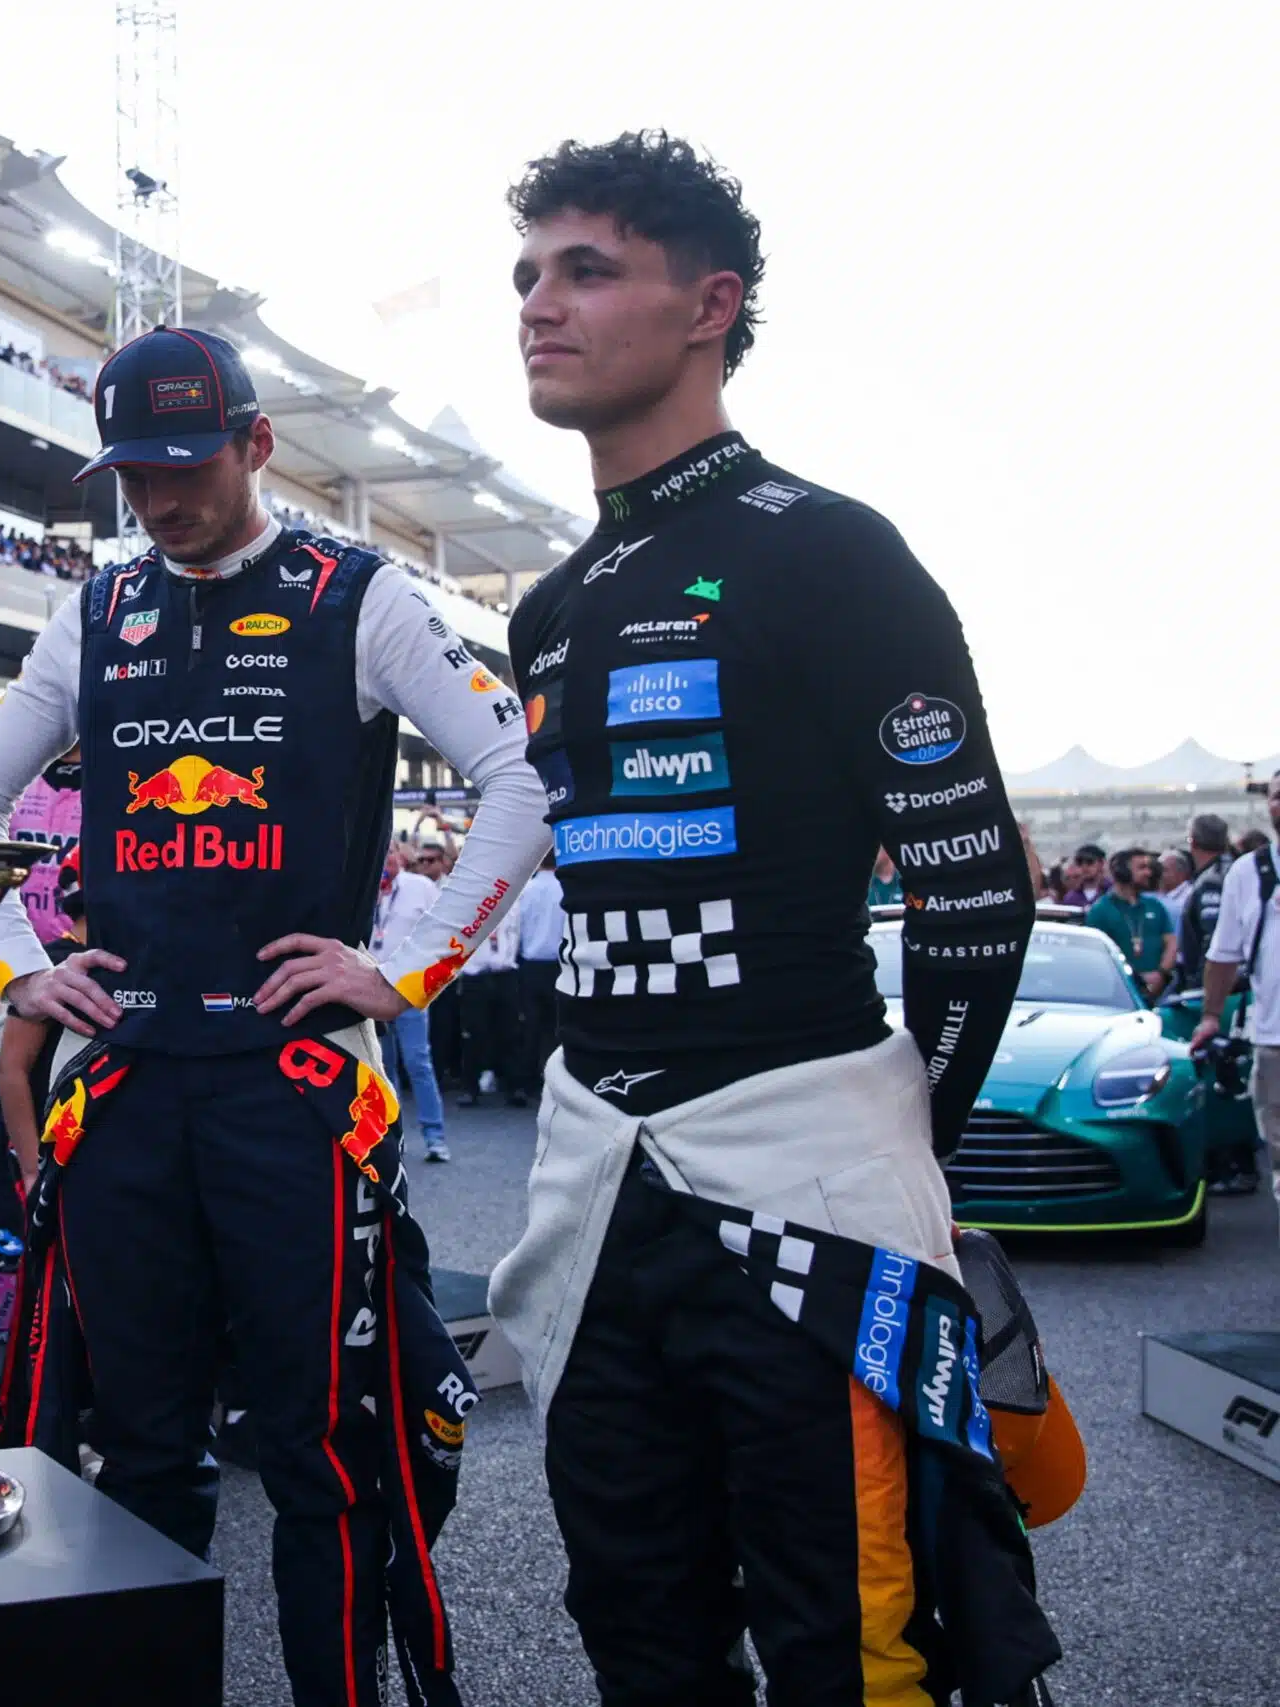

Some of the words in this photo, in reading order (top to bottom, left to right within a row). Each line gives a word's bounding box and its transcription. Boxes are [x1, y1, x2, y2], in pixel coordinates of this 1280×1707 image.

[157, 381, 202, 392] ORACLE
[104, 384, 116, 420] 1
[651, 442, 747, 501] MONSTER
[128, 613, 157, 626] TAG
[246, 621, 282, 631] RAUCH
[620, 620, 698, 636] McLaren
[104, 660, 148, 682] Mobil
[223, 687, 287, 697] HONDA
[113, 716, 284, 748] ORACLE
[892, 709, 951, 734] Estrella
[897, 725, 952, 749] Galicia
[624, 748, 713, 784] allwyn
[910, 776, 988, 809] Dropbox
[116, 823, 185, 872] Red
[194, 824, 284, 871] Bull
[561, 819, 723, 856] Technologies
[461, 907, 489, 938] Red
[482, 878, 510, 911] Bull
[925, 889, 1015, 912] Airwallex
[928, 941, 1018, 958] CASTORE
[114, 989, 157, 1008] sparco
[937, 1000, 969, 1055] MILLE
[858, 1251, 913, 1396] hnologie
[922, 1314, 957, 1427] allwyn
